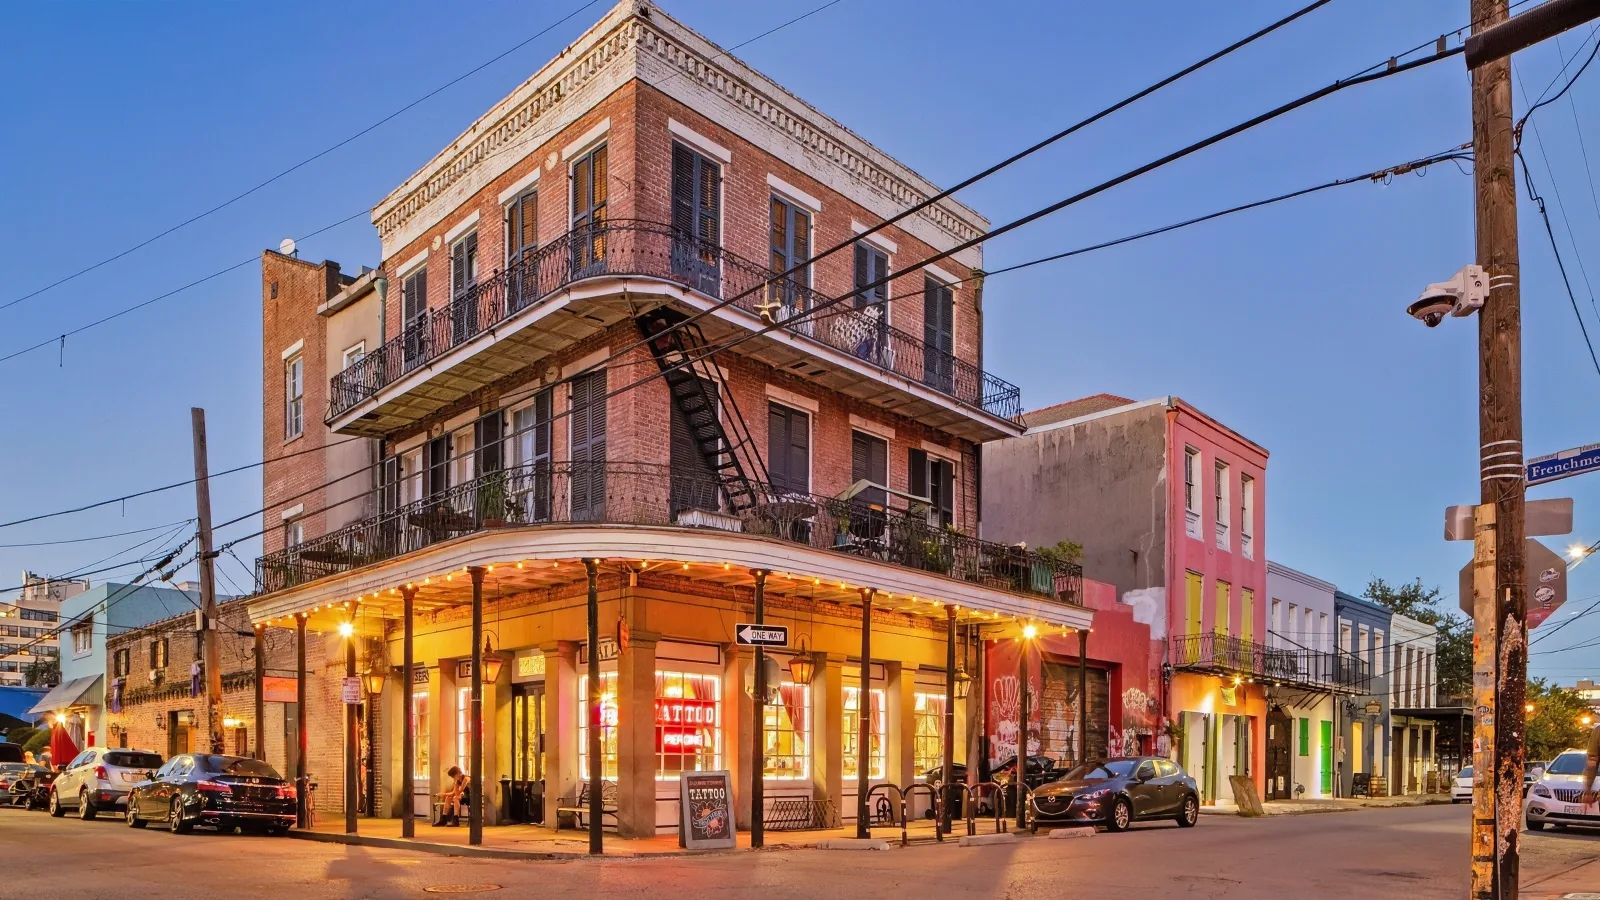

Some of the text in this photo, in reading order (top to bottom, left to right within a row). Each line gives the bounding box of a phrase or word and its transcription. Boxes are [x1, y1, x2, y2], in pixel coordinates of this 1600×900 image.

[751, 631, 783, 641] ONE WAY
[655, 703, 714, 724] ATTOO
[689, 788, 725, 800] TATTOO
